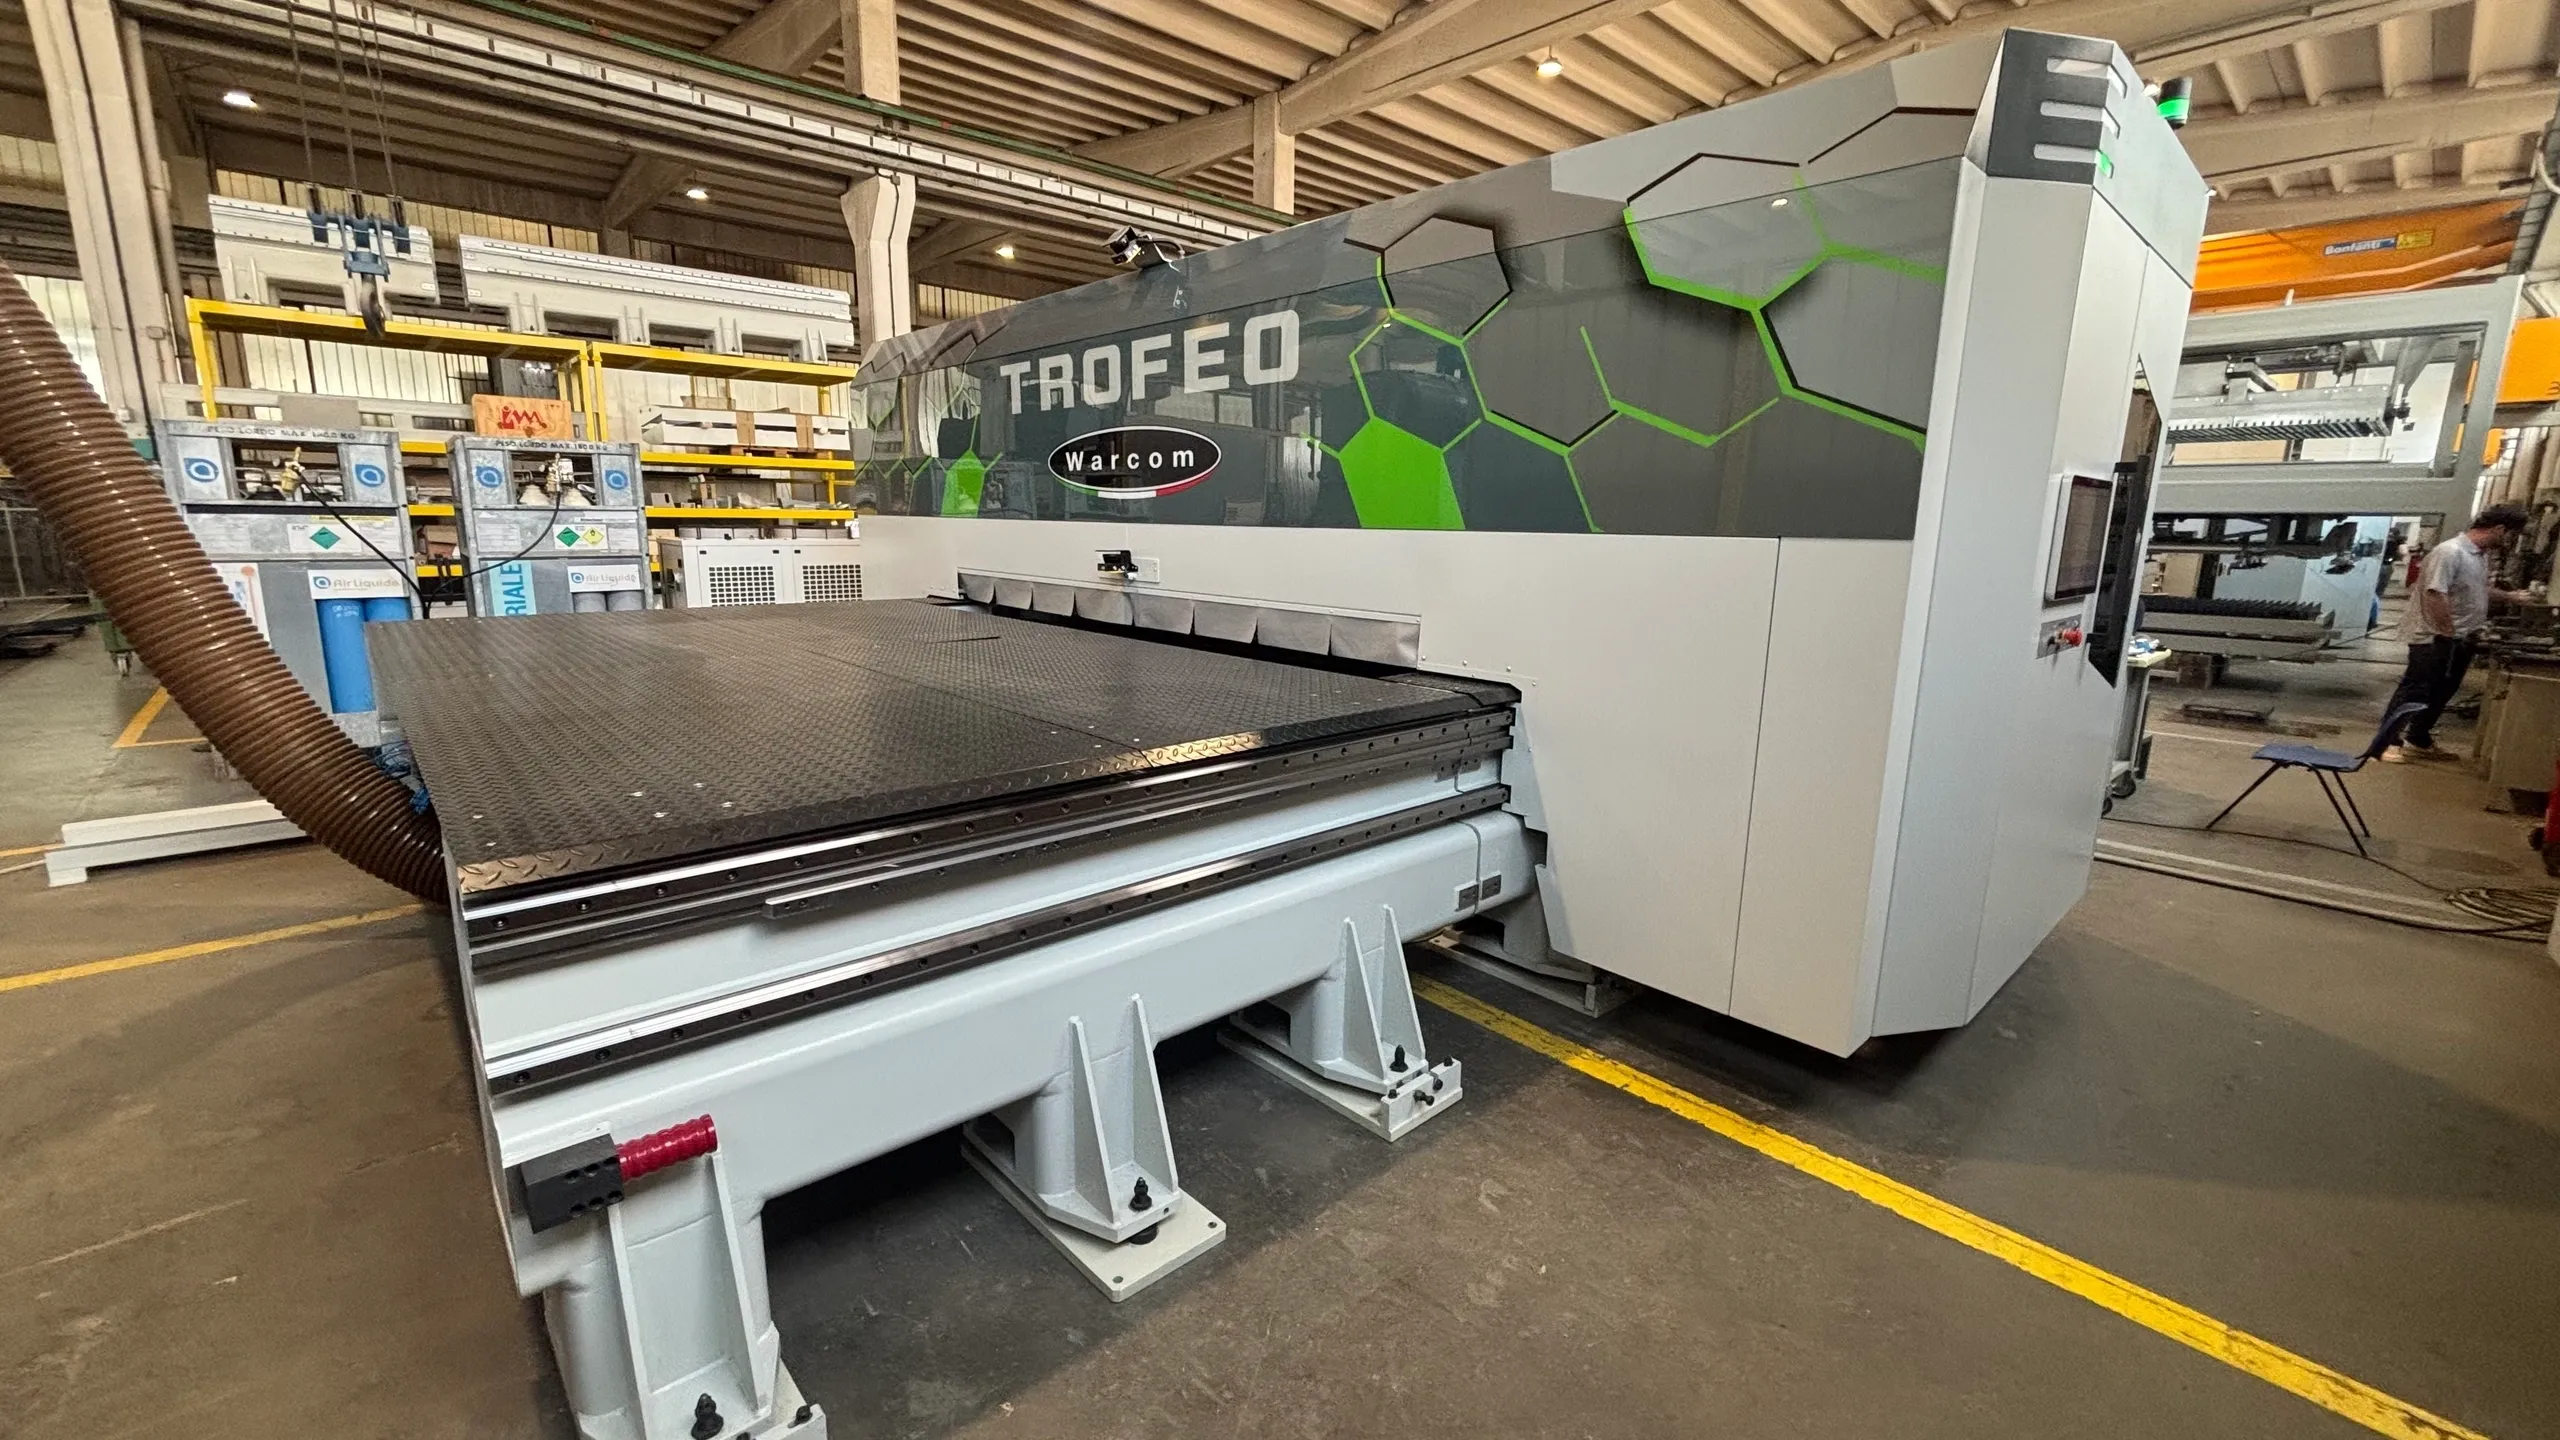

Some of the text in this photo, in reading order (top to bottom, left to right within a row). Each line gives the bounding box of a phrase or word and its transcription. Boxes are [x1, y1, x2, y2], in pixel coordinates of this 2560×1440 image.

[2324, 240, 2381, 255] Bonfanti
[1000, 308, 1300, 415] TROFEO
[1065, 447, 1195, 472] Warcom
[333, 578, 400, 590] Air Liquide
